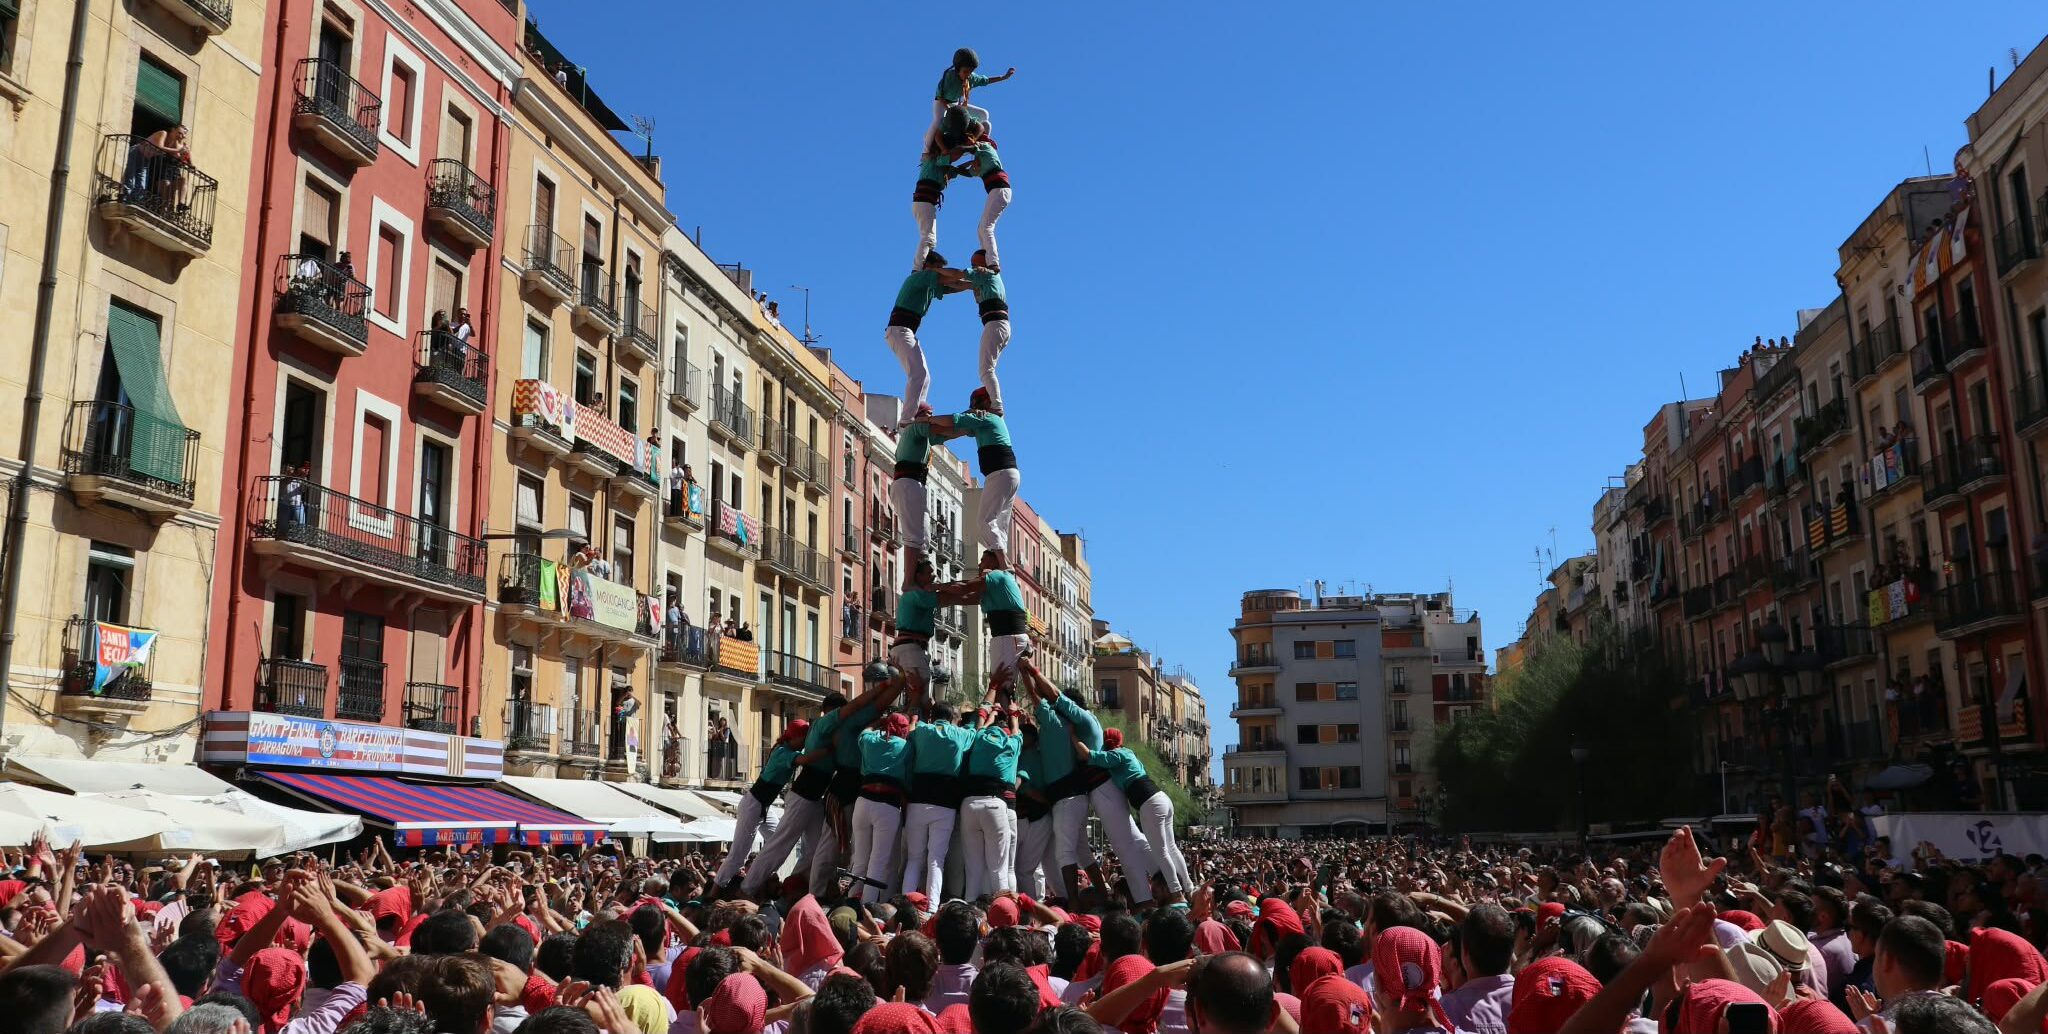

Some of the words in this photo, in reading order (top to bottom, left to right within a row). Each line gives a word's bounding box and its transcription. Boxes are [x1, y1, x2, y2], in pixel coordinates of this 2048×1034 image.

[101, 630, 127, 648] SANTA
[249, 721, 278, 738] GRAN
[280, 720, 317, 739] PENYA
[340, 727, 403, 748] BARCELONISTA
[256, 740, 304, 756] TARRAGONA
[361, 749, 396, 762] PROVINCIA
[436, 831, 448, 842] BAR
